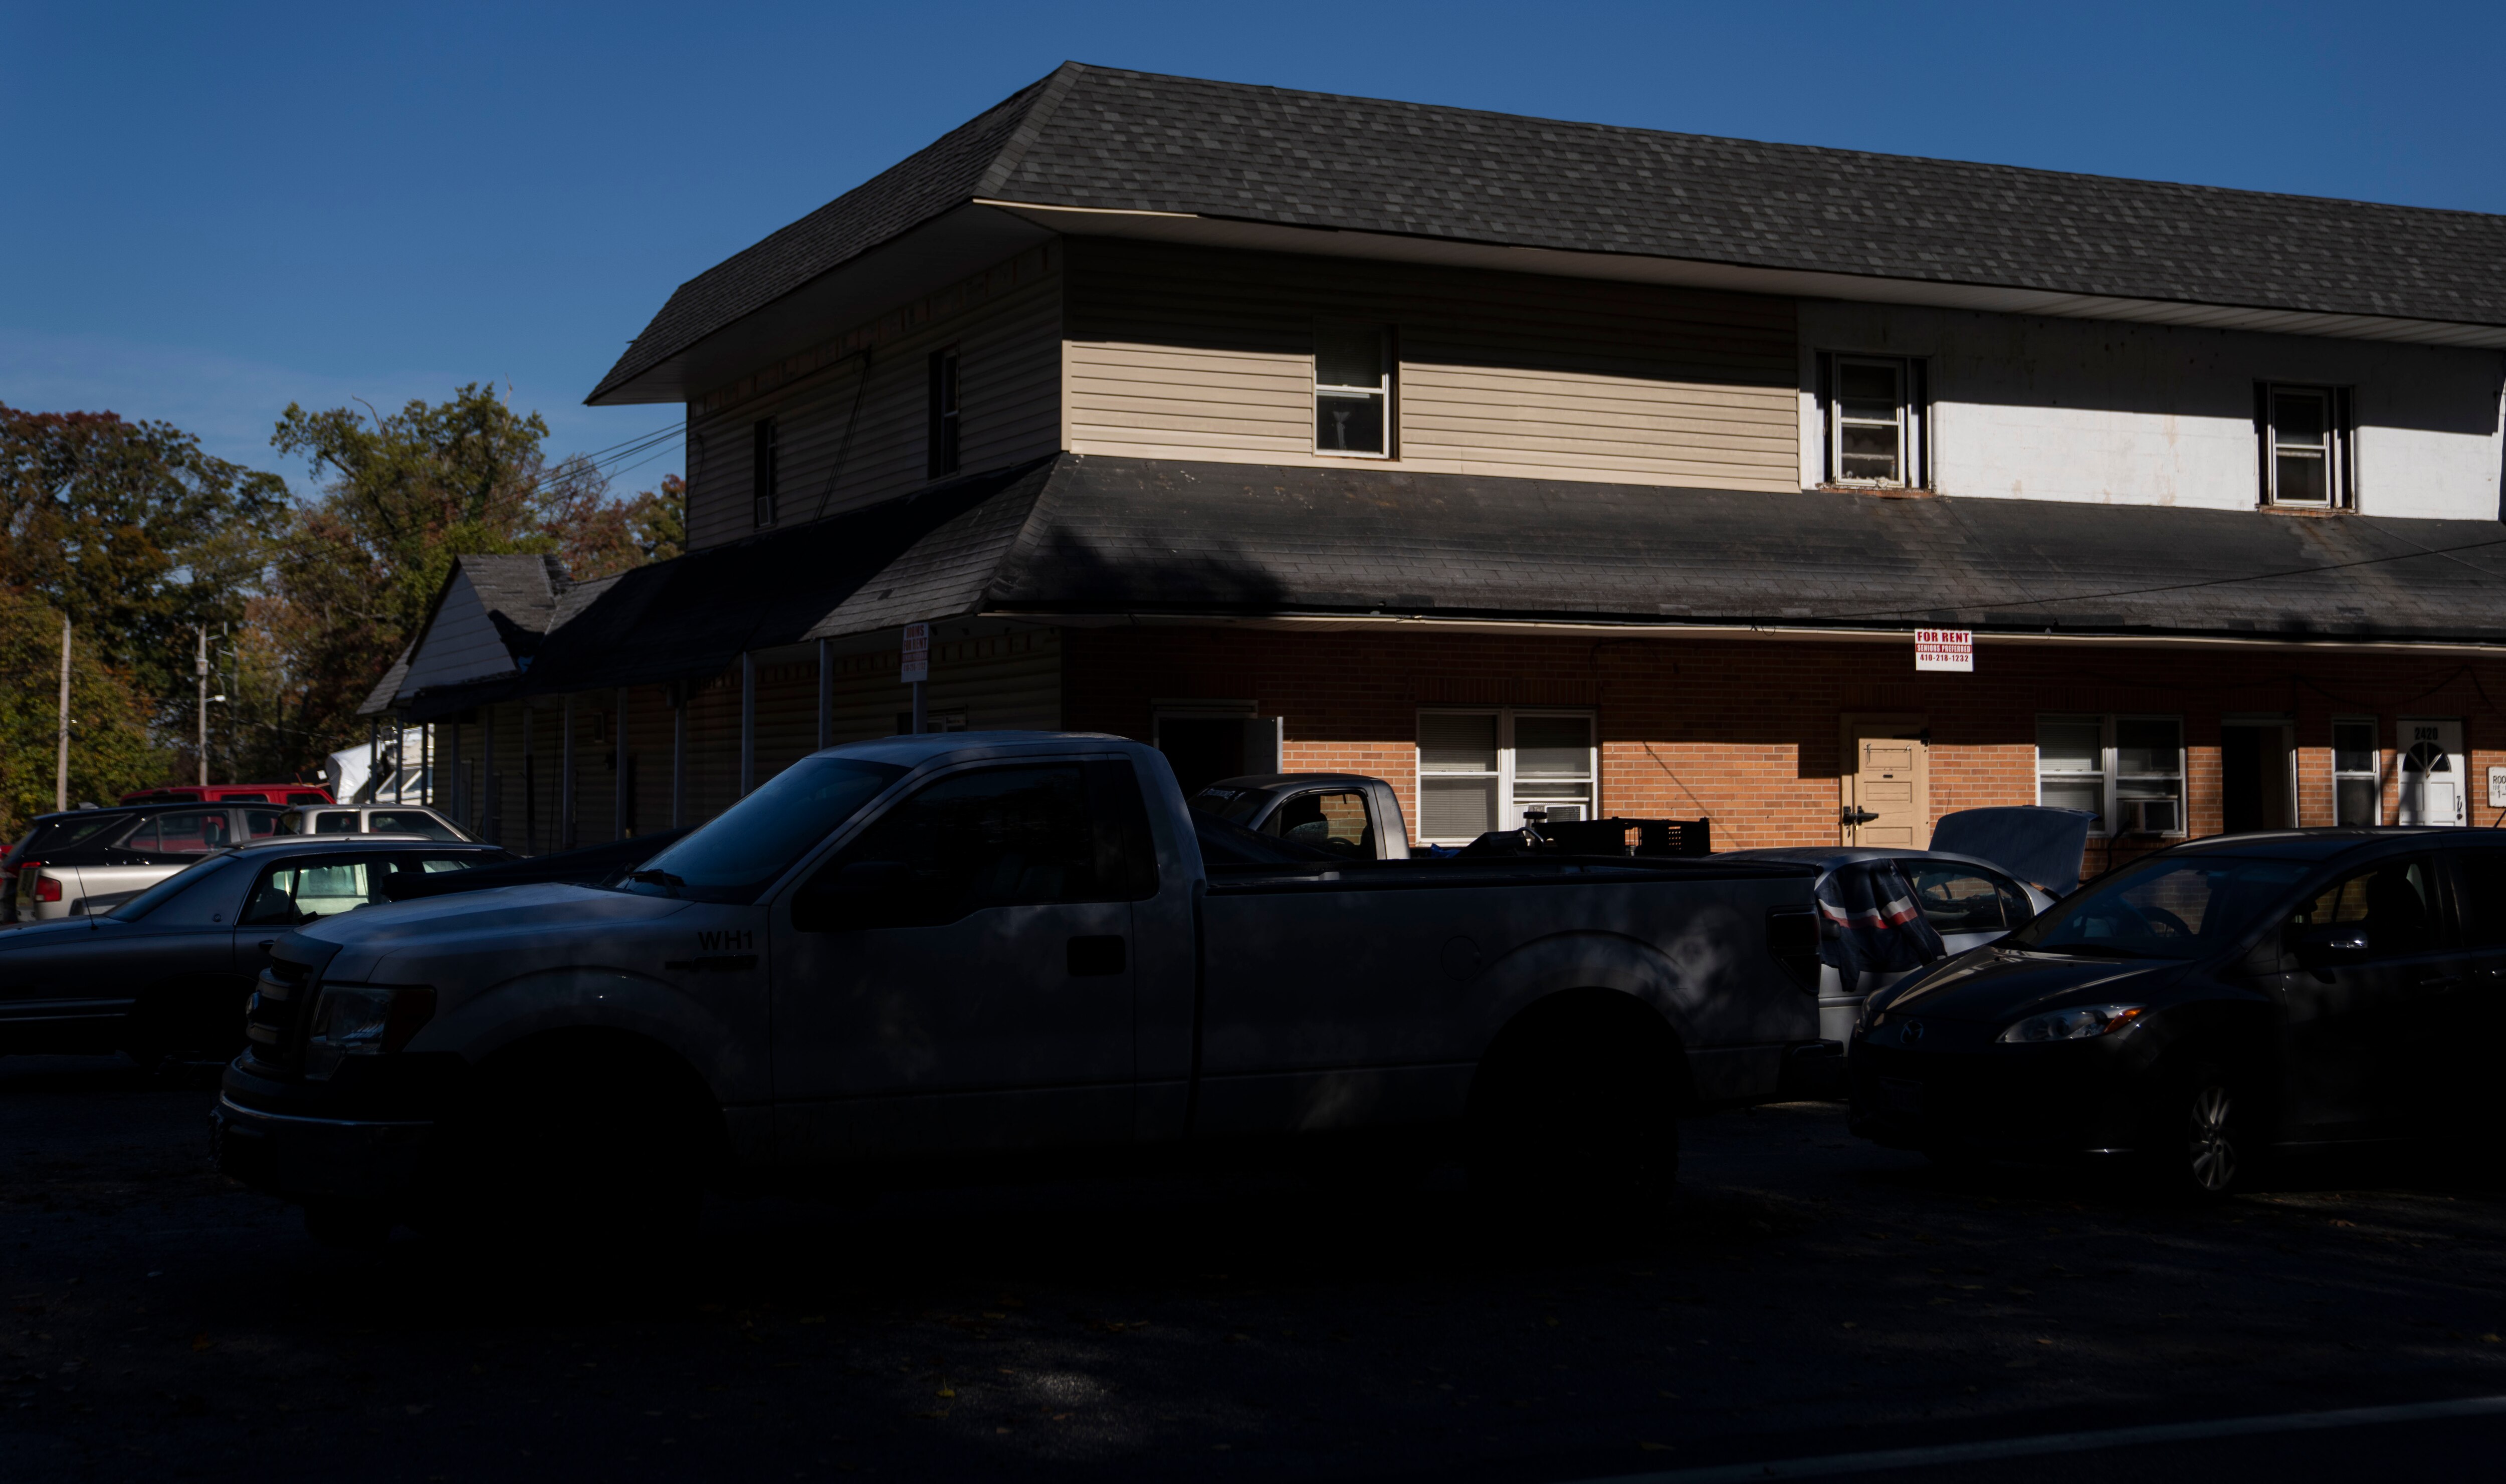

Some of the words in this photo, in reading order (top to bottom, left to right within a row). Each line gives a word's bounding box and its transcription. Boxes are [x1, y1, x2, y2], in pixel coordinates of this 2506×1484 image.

[1917, 631, 1938, 642] FOR
[1942, 632, 1969, 643] RENT
[1942, 645, 1971, 653] PREFERRED
[1920, 654, 1969, 662] 410-218-1232
[2415, 728, 2438, 740] 2420
[698, 930, 752, 951] WH1
